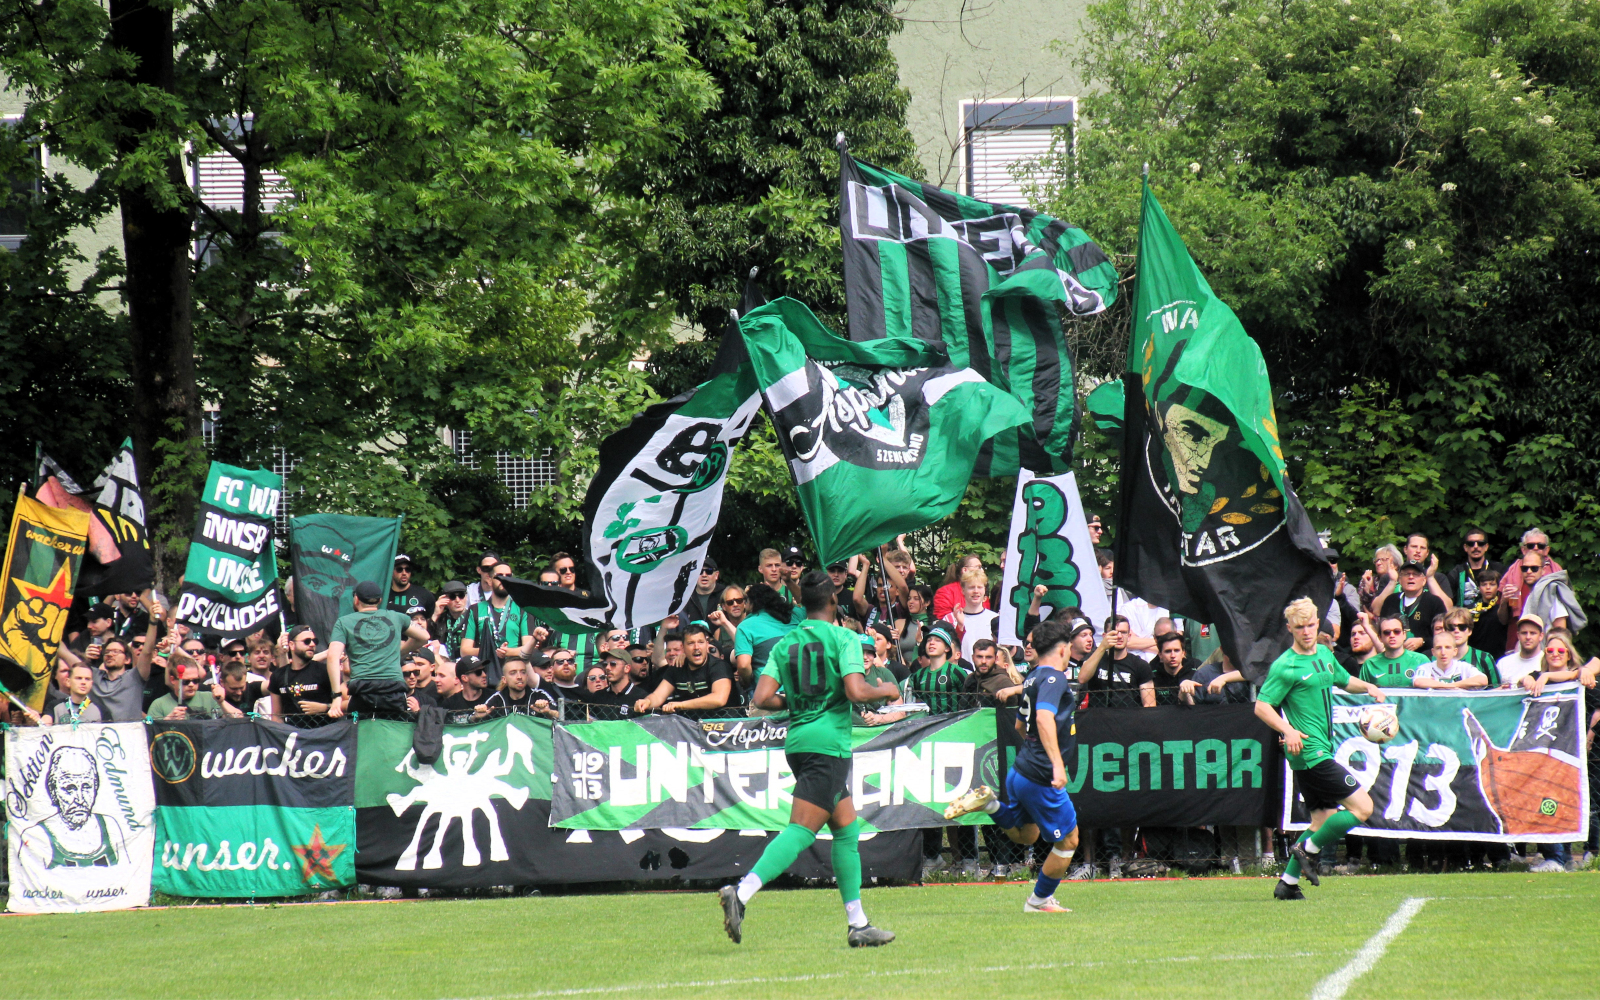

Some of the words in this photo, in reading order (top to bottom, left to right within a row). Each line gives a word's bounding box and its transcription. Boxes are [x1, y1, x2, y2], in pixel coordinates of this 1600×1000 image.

[213, 475, 244, 507] FC
[175, 588, 279, 631] PSYCHOSE
[788, 641, 826, 696] 10
[200, 731, 347, 779] wacker
[571, 751, 605, 772] 19
[96, 726, 146, 832] Edmund
[571, 780, 603, 800] 13
[1334, 736, 1461, 828] 913
[1053, 829, 1062, 839] 9
[161, 837, 292, 872] unser.
[86, 886, 128, 898] unser.
